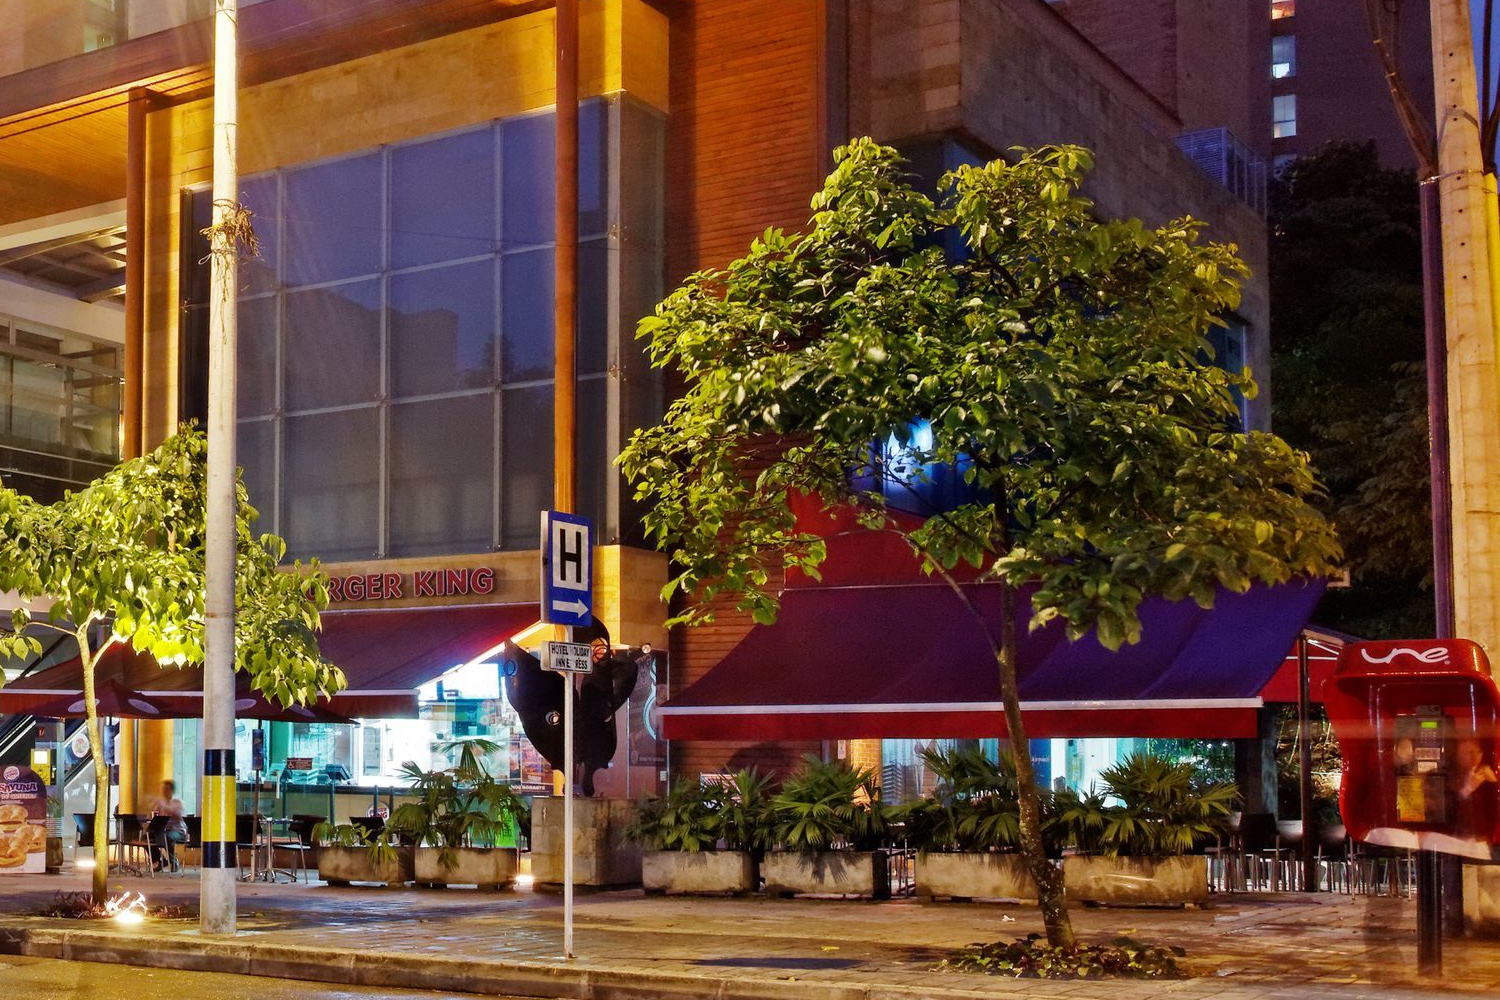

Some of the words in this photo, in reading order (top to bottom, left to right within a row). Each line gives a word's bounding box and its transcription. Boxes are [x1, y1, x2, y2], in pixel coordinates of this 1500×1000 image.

[560, 528, 581, 583] H
[304, 572, 402, 602] RGER
[413, 567, 493, 597] KING
[551, 644, 569, 656] HOTEL
[1361, 647, 1449, 664] une
[566, 658, 588, 670] ERESS
